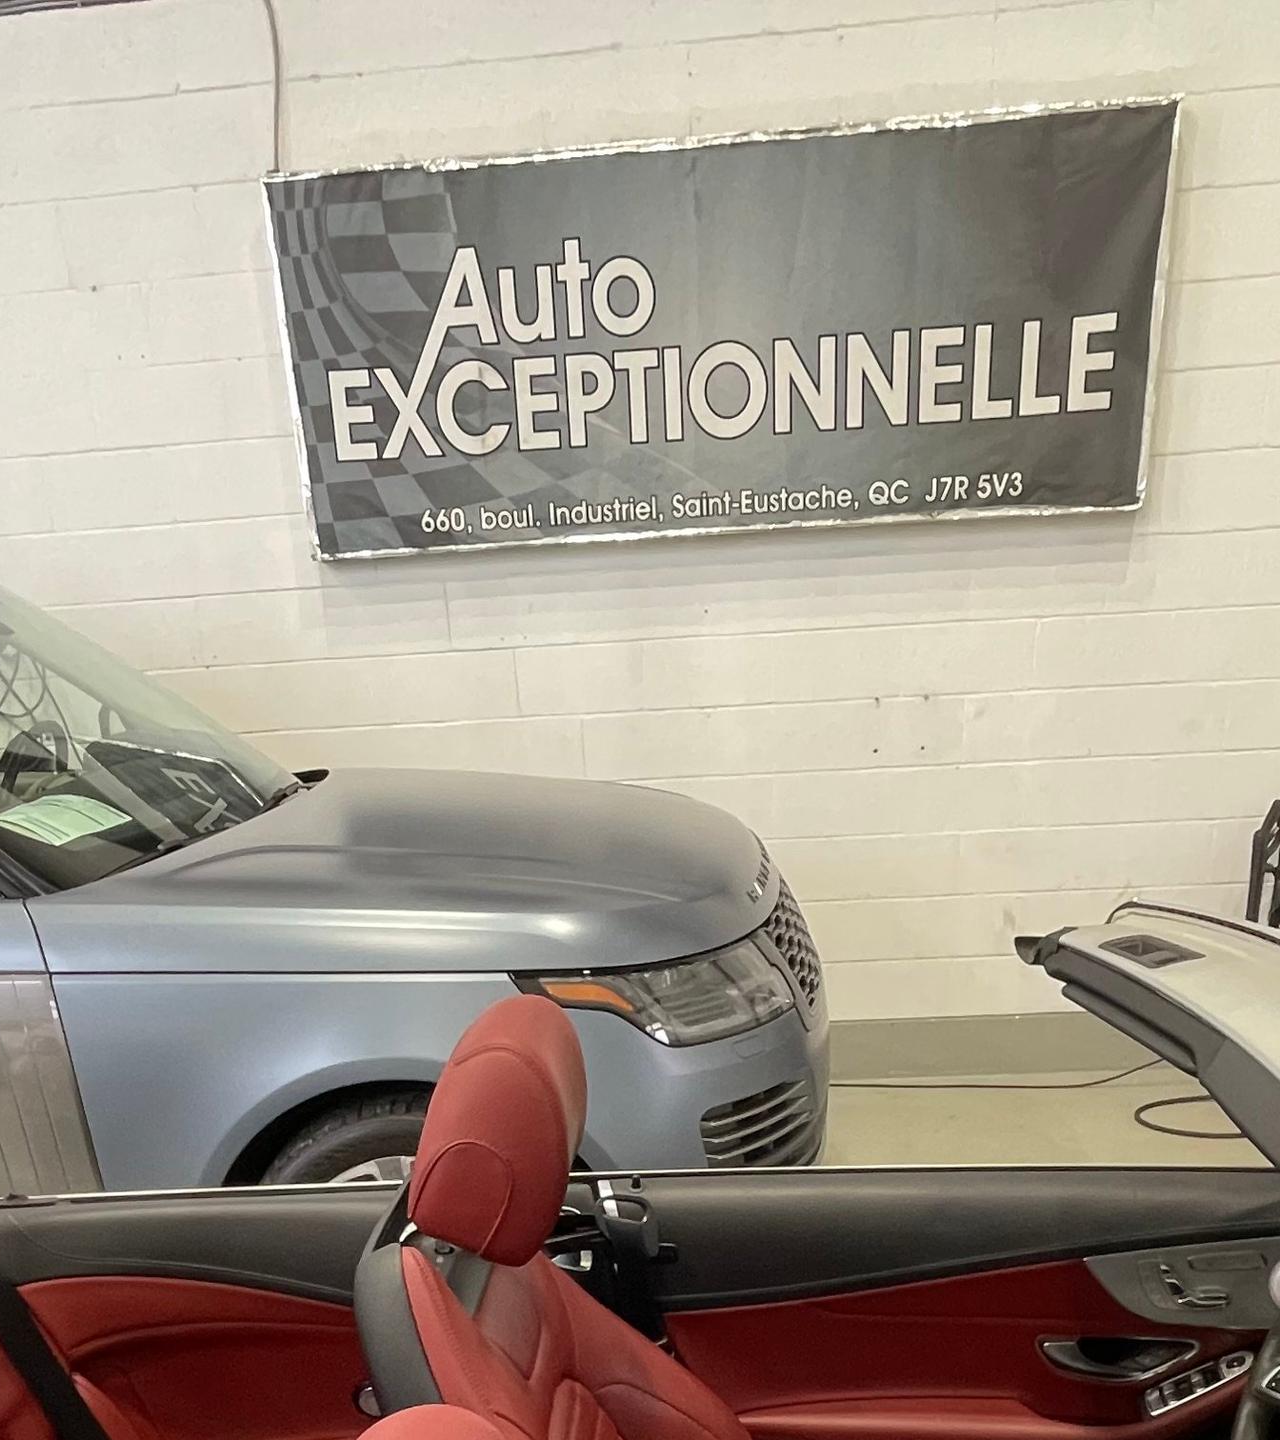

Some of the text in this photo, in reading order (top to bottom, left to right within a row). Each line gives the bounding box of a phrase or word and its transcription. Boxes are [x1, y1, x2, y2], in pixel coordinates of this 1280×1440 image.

[428, 238, 655, 345] Auto
[327, 311, 1120, 462] EXCEPTIONNELLE
[420, 471, 1024, 534] 660, boul. Industriel, Saint-Eustache, QC J7R 5V3
